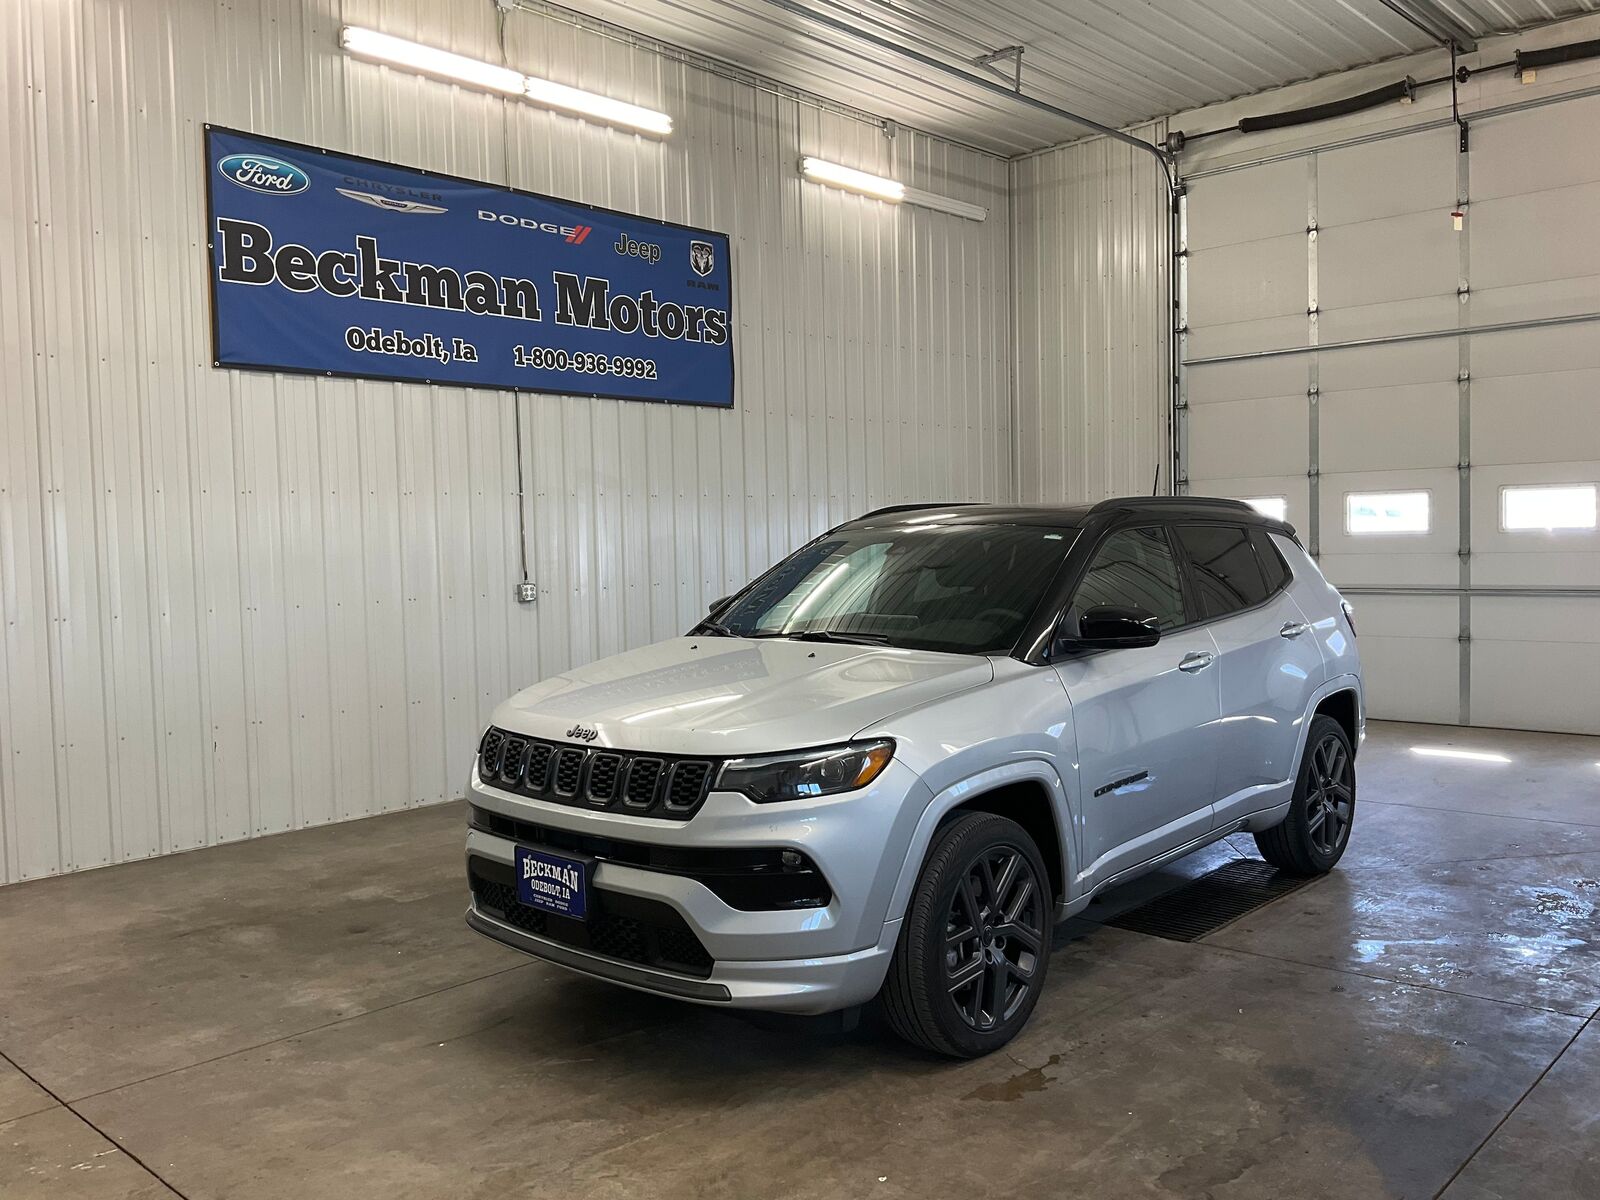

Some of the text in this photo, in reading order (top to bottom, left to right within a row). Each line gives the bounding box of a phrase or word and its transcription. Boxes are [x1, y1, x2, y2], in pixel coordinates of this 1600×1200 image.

[236, 159, 294, 190] Ford
[343, 176, 443, 202] CHRYSLER
[477, 209, 577, 238] DODGE
[614, 233, 661, 265] Jeep
[217, 217, 728, 345] Beckman Motors
[686, 279, 720, 292] RAM
[345, 326, 657, 380] Odebolt, Ia 1-800-936-9992
[566, 724, 599, 743] Jeep
[523, 858, 578, 892] BECKMAN
[562, 887, 570, 899] IA
